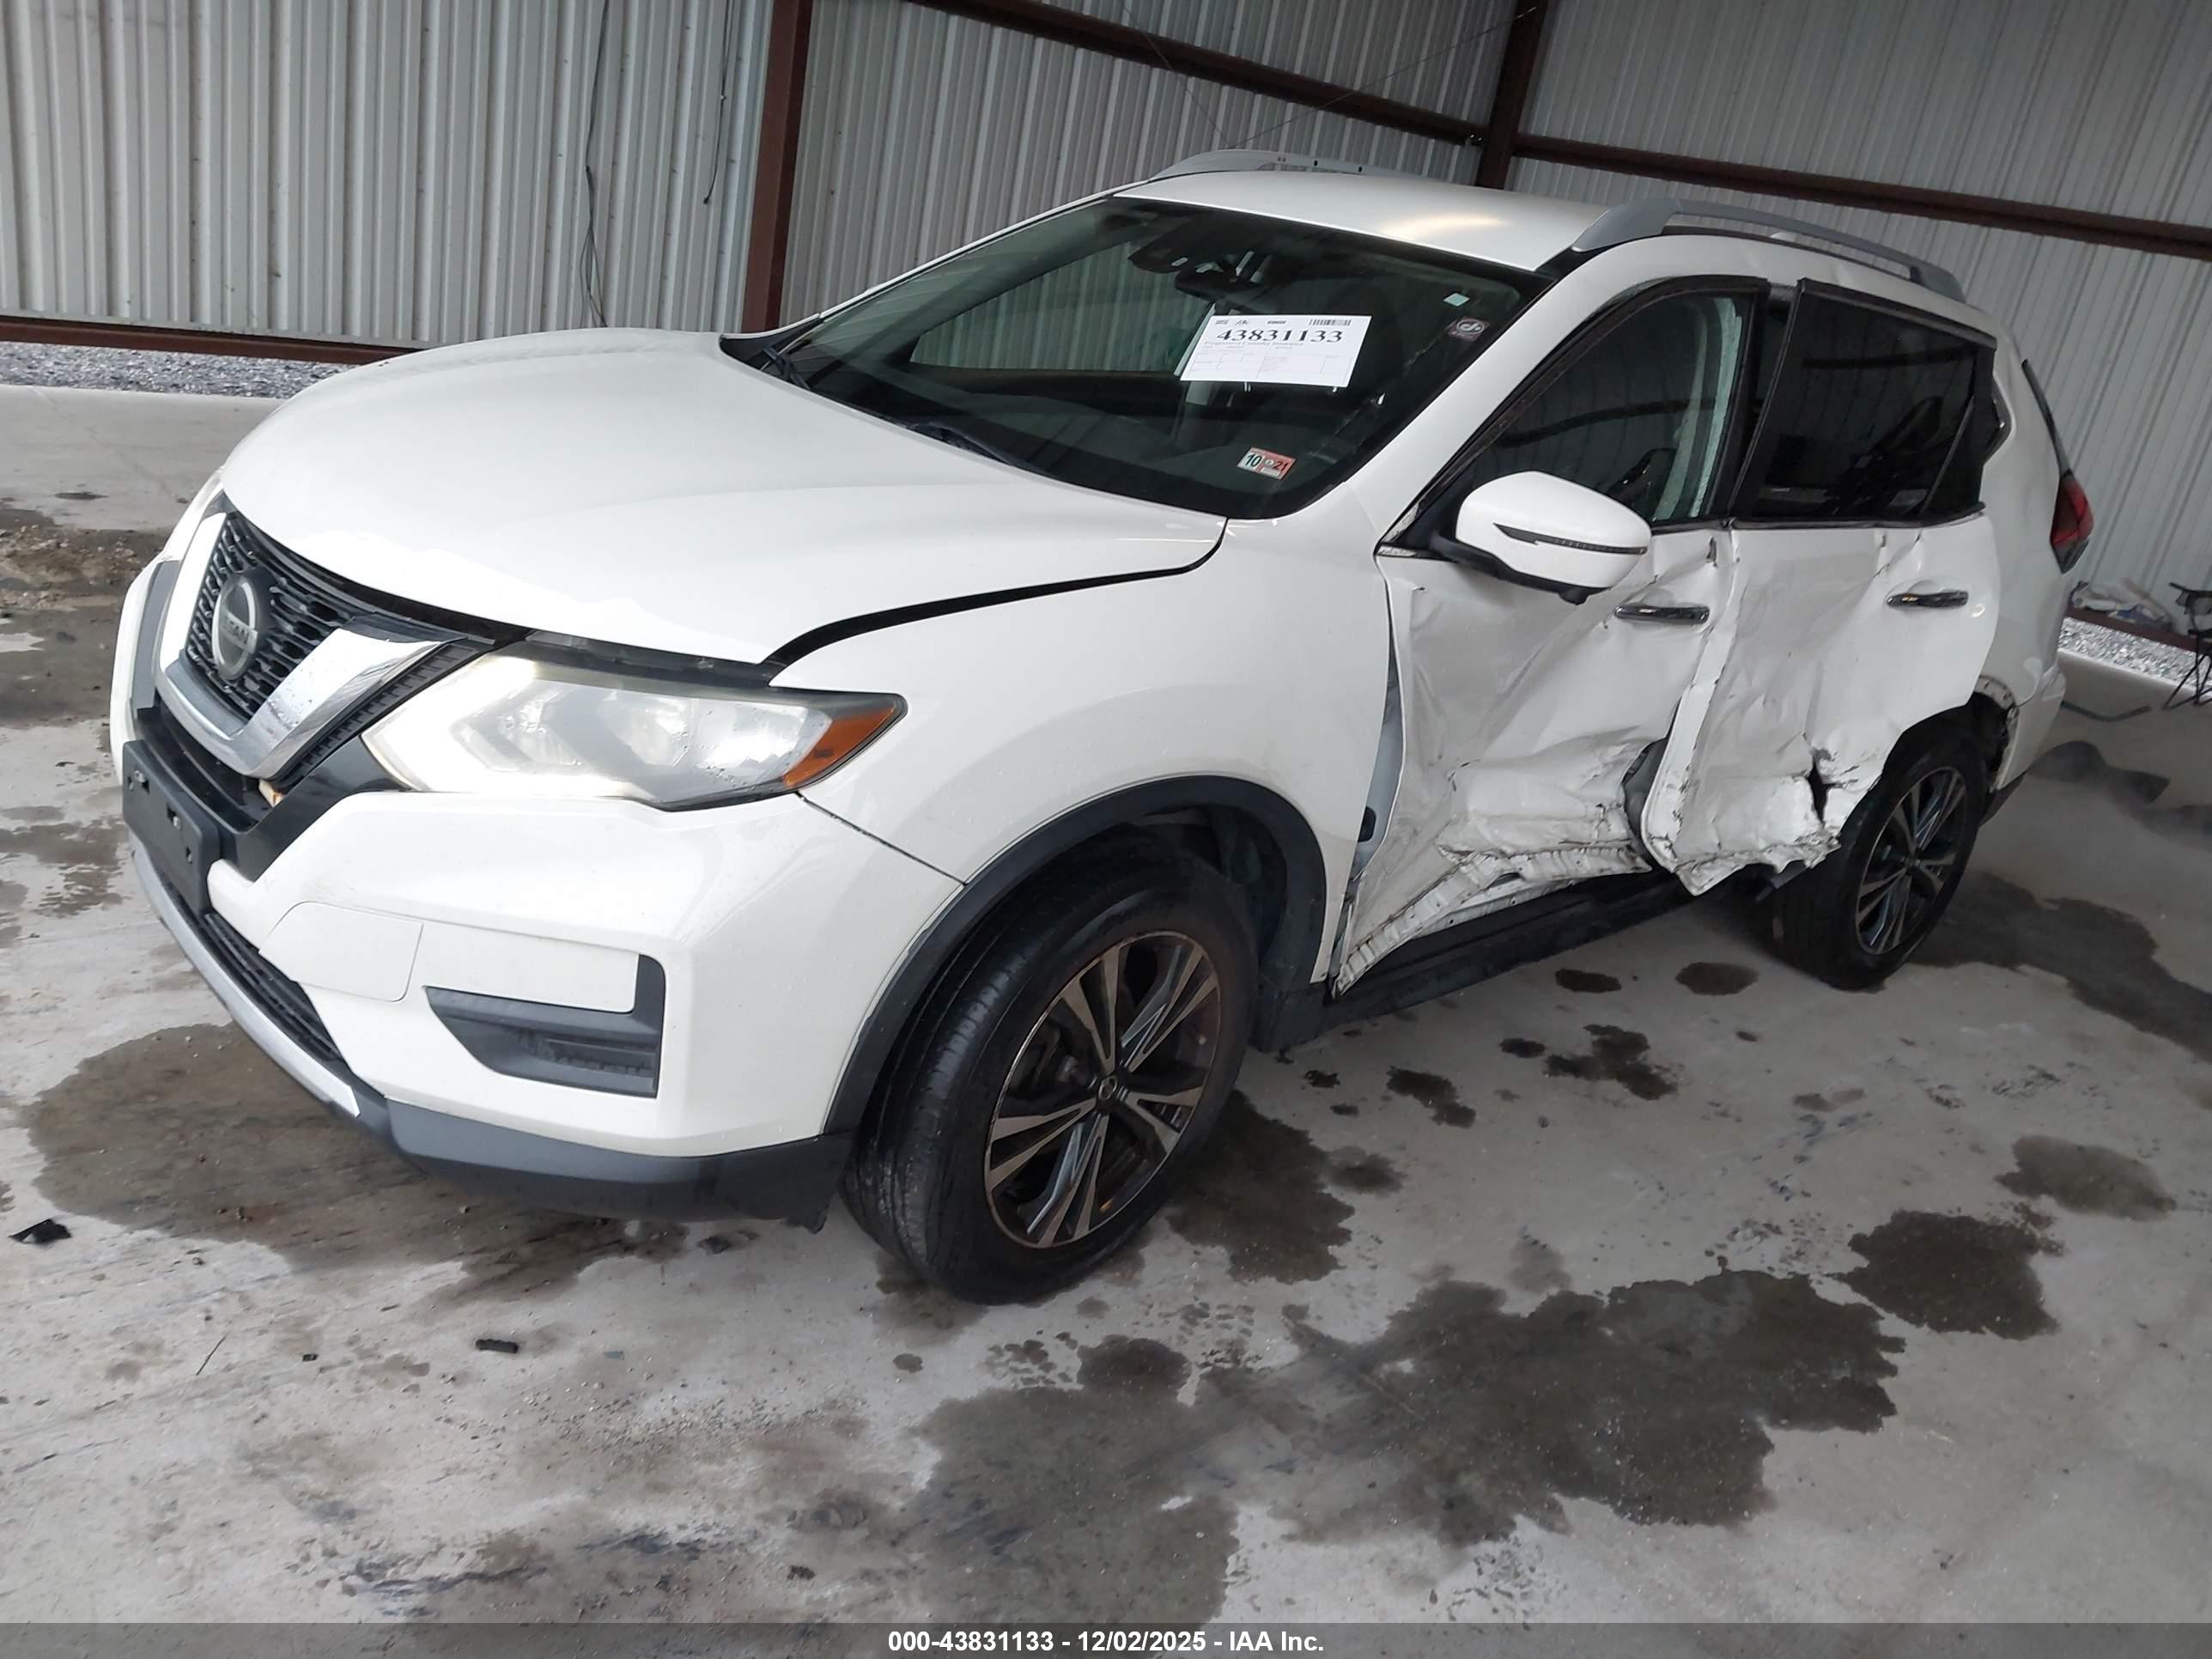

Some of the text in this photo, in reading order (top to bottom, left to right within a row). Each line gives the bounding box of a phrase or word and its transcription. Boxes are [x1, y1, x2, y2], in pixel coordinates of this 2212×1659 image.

[1216, 329, 1344, 343] 43831133
[1245, 453, 1263, 468] 10
[1273, 460, 1289, 471] 21
